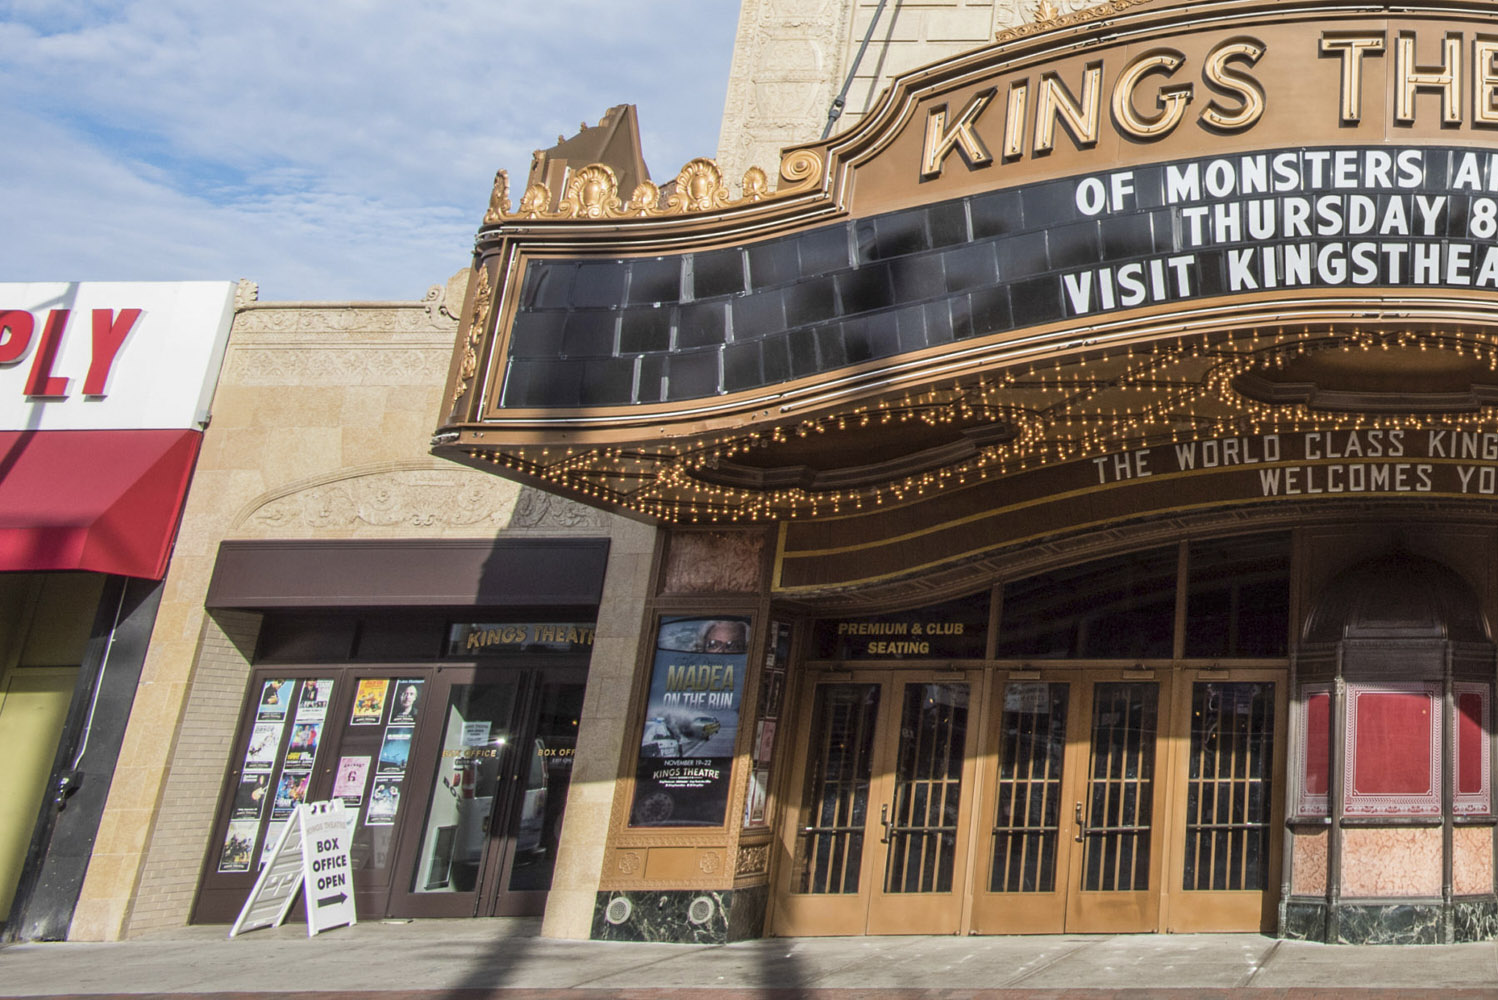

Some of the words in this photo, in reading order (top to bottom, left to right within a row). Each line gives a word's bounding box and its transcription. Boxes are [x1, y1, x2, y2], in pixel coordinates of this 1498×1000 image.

[920, 36, 1267, 183] KINGS
[1075, 171, 1134, 216] OF
[1165, 150, 1423, 203] MONSTERS
[1182, 194, 1447, 246] THURSDAY
[1064, 255, 1195, 314] VISIT
[1093, 450, 1153, 484] THE
[1175, 434, 1281, 471] WORLD
[1305, 430, 1405, 460] CLASS
[1259, 463, 1432, 496] WELCOMES
[466, 626, 527, 649] KINGS
[838, 623, 908, 635] PREMIUM
[911, 623, 922, 635] &
[926, 623, 964, 635] CLUB
[867, 641, 930, 654] SEATING
[666, 664, 734, 692] MADEA
[708, 692, 733, 709] RUN
[537, 749, 556, 757] BOX
[653, 768, 680, 779] KINGS
[683, 768, 720, 779] THEATRE
[316, 838, 339, 853] BOX
[312, 855, 347, 872] OFFICE
[317, 873, 346, 890] OPEN
